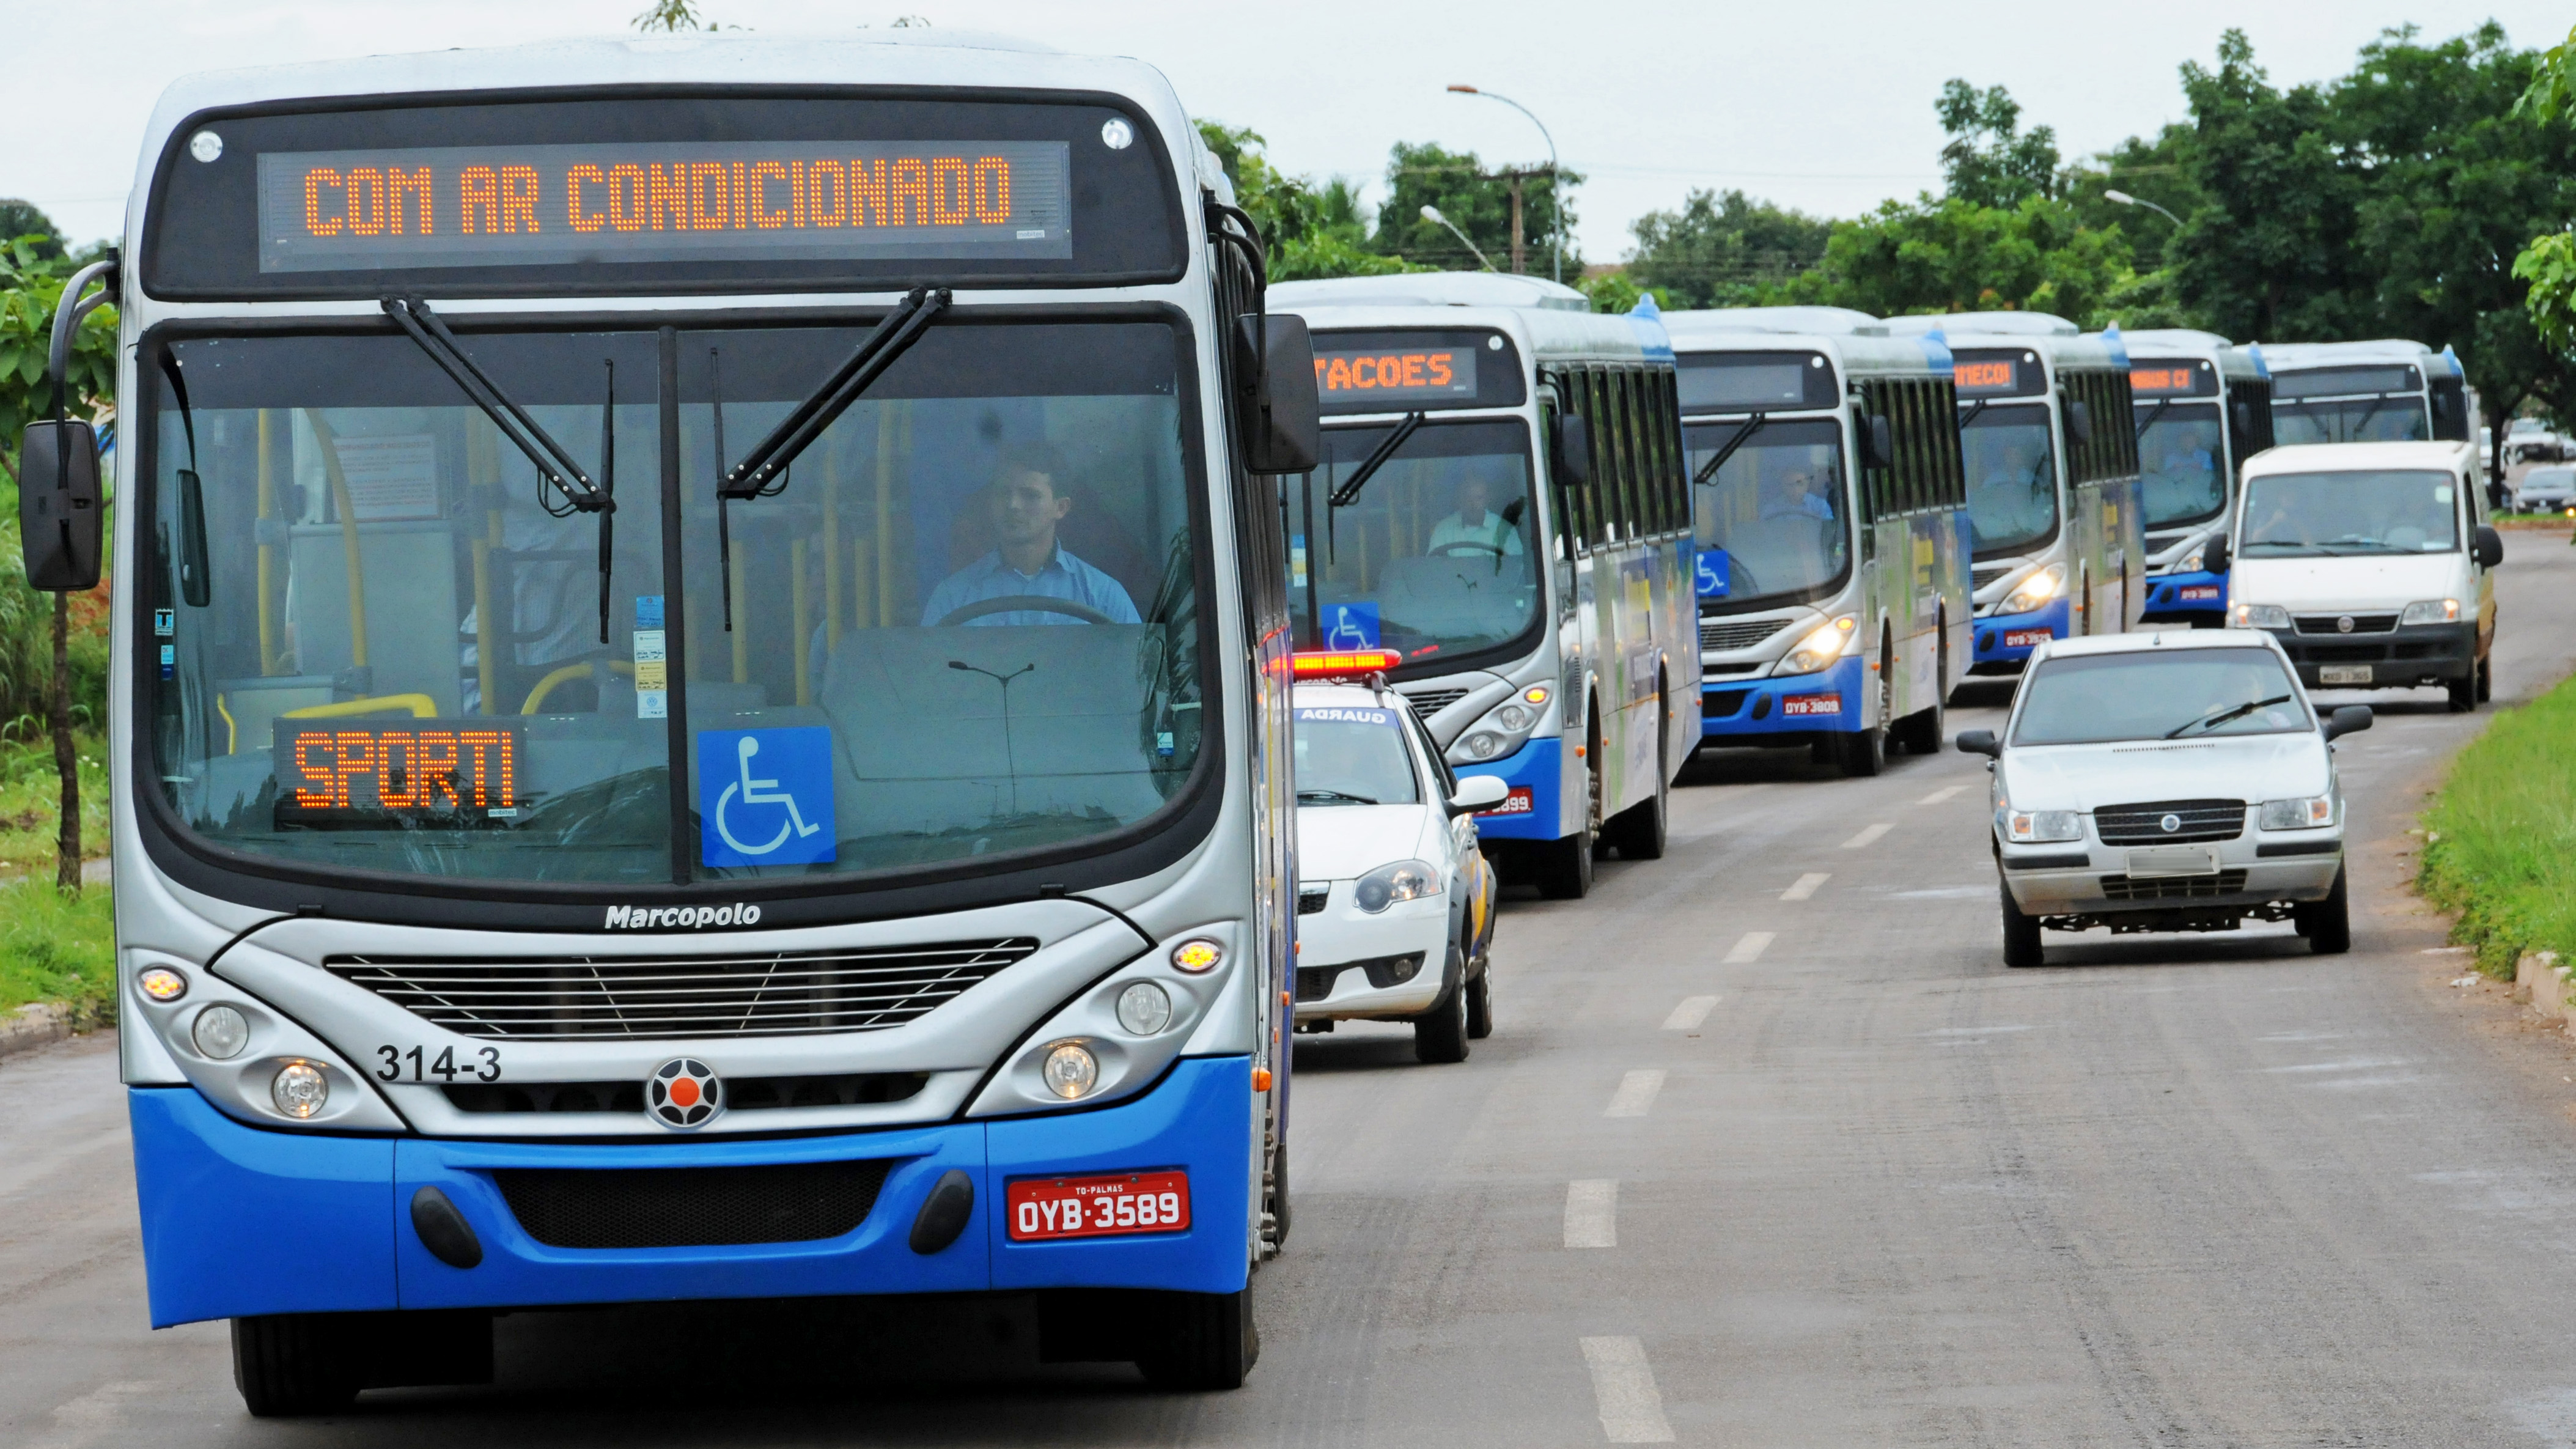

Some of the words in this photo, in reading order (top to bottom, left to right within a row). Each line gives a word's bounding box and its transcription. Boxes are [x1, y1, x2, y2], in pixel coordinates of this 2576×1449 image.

[306, 167, 434, 237] COM
[460, 166, 541, 235] AR
[568, 157, 1010, 232] CONDICIONADO
[605, 902, 761, 929] Marcopolo
[377, 1044, 501, 1082] 314-3
[1076, 1185, 1124, 1195] TO-PALMAS
